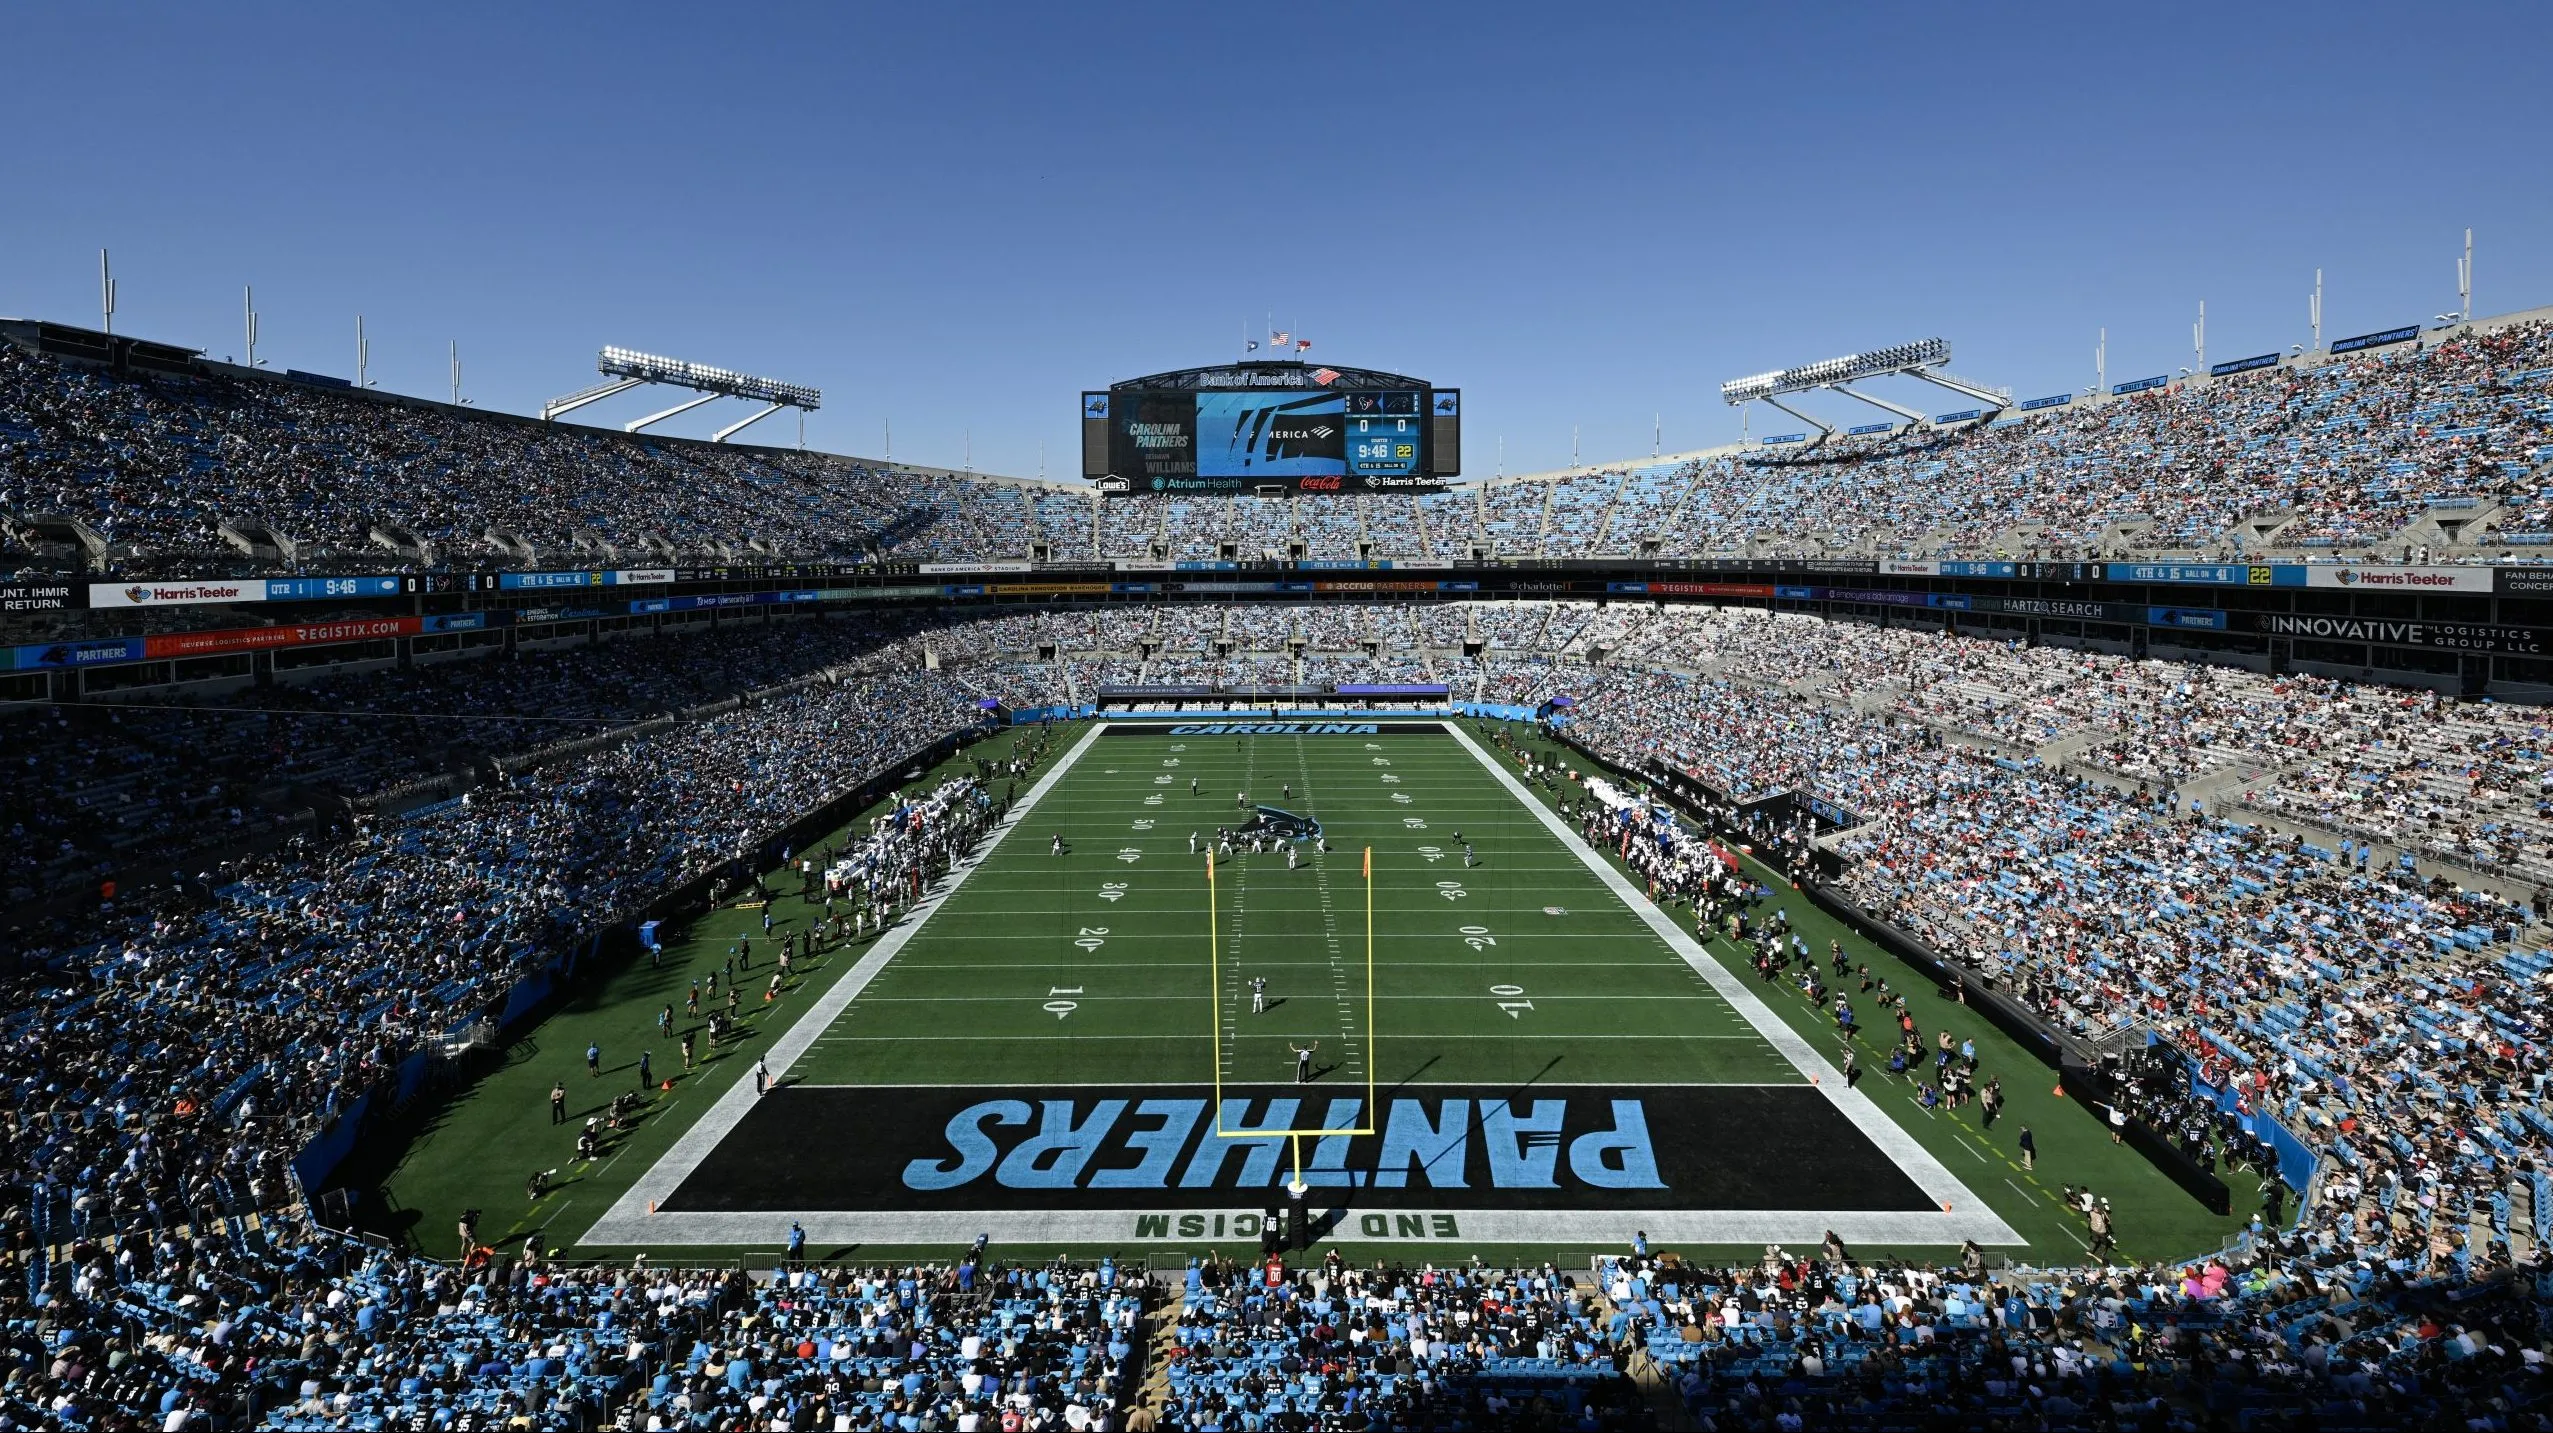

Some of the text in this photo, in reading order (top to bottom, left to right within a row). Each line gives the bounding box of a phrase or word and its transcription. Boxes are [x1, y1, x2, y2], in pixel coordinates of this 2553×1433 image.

[2334, 329, 2414, 353] CAROLINA PANTHERS
[2213, 357, 2277, 376] CAROLINA PANTHERS
[1200, 372, 1304, 387] Bank of America
[1129, 423, 1180, 436] CAROLINA
[1360, 419, 1368, 433] 0
[1397, 419, 1406, 432] 0
[1135, 435, 1189, 448] PANTHERS
[1359, 444, 1388, 458] 9:46
[1396, 445, 1412, 458] 22
[1145, 461, 1196, 474] WILLIAMS
[1167, 478, 1242, 489] Atrium Health
[1382, 476, 1446, 487] Harris Teeter
[1968, 563, 1987, 575] 9:46
[2021, 564, 2028, 577] 0
[2091, 565, 2100, 579] 0
[2135, 567, 2154, 578] 4TH
[2157, 567, 2165, 578] &
[2169, 568, 2180, 580] 15
[2249, 567, 2271, 584] 22
[2505, 571, 2526, 580] FAN
[486, 575, 493, 589] 0
[591, 573, 601, 584] 22
[636, 573, 651, 581] Harris
[2361, 571, 2455, 586] Harris Teeter
[271, 583, 303, 595] QTR 1
[326, 579, 357, 595] 9:46
[407, 578, 416, 592] 0
[1336, 581, 1425, 590] accrue PARTNERS
[1661, 584, 1704, 593] REGISTIX
[32, 587, 70, 598] IHMIR
[154, 586, 240, 600] Harris Teeter
[4, 599, 65, 611] RETURN.
[2003, 599, 2040, 612] HARTZ
[2051, 601, 2102, 617] SEARCH
[2181, 616, 2214, 627] PARTNERS
[296, 622, 400, 640] REGISTIX.COM
[2271, 615, 2423, 644] INNOVATIVE
[2434, 626, 2532, 640] LOGISTICS
[2434, 637, 2540, 653] GROUP LLC
[76, 647, 127, 661] PARTNERS
[1168, 724, 1378, 735] CAROLINA
[1098, 881, 1129, 898] 30
[1436, 881, 1467, 897] 30
[1074, 926, 1110, 947] 20
[1459, 925, 1496, 946] 20
[1043, 985, 1084, 1014] 10
[1490, 984, 1535, 1013] 10
[901, 1098, 1671, 1190] PANTHERS
[1362, 1213, 1460, 1239] END
[1270, 1271, 1282, 1282] 00
[2010, 1302, 2017, 1314] 9
